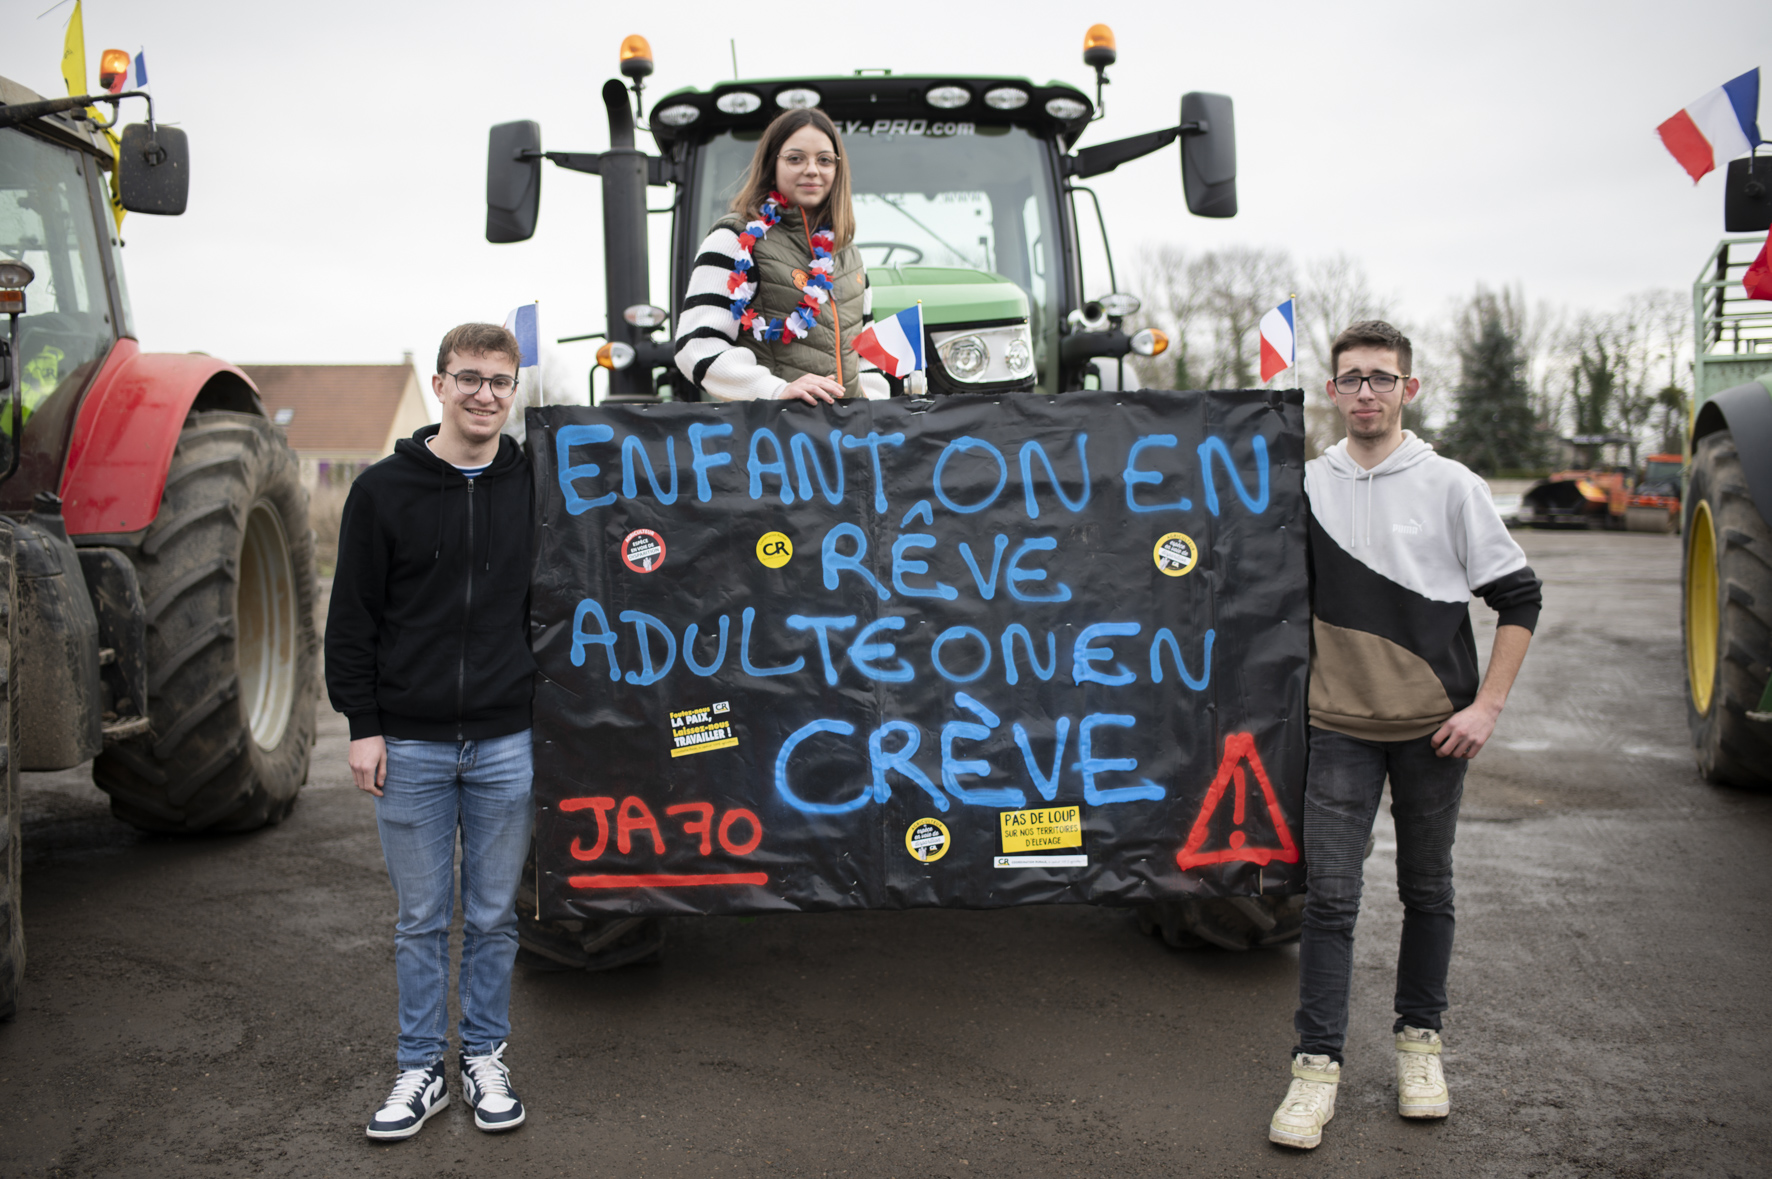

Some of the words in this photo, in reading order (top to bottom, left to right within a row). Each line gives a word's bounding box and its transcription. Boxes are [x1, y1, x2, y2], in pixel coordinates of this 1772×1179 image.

[556, 422, 906, 516] ENFANT
[933, 432, 1091, 519] ON
[1123, 434, 1270, 516] EN
[1392, 523, 1418, 535] PUMA
[762, 541, 790, 556] CR
[821, 499, 1073, 602] RÊVE
[569, 598, 915, 687] ADULTE
[931, 622, 1057, 686] ON
[1072, 621, 1216, 691] EN
[669, 706, 711, 719] Foutez-nous
[715, 702, 729, 711] CR
[670, 717, 684, 728] LA
[685, 712, 712, 725] PAIX,
[672, 720, 730, 738] Laissez-nous
[673, 728, 726, 748] TRAVAILLER
[774, 691, 1167, 815] CRÈVE
[1004, 813, 1026, 826] PAS
[1030, 812, 1044, 825] DE
[1048, 809, 1076, 824] LOUP
[1004, 829, 1018, 838] SUR
[1020, 828, 1034, 837] NOS
[1036, 824, 1079, 835] TERRITOIRES
[997, 858, 1010, 866] CR
